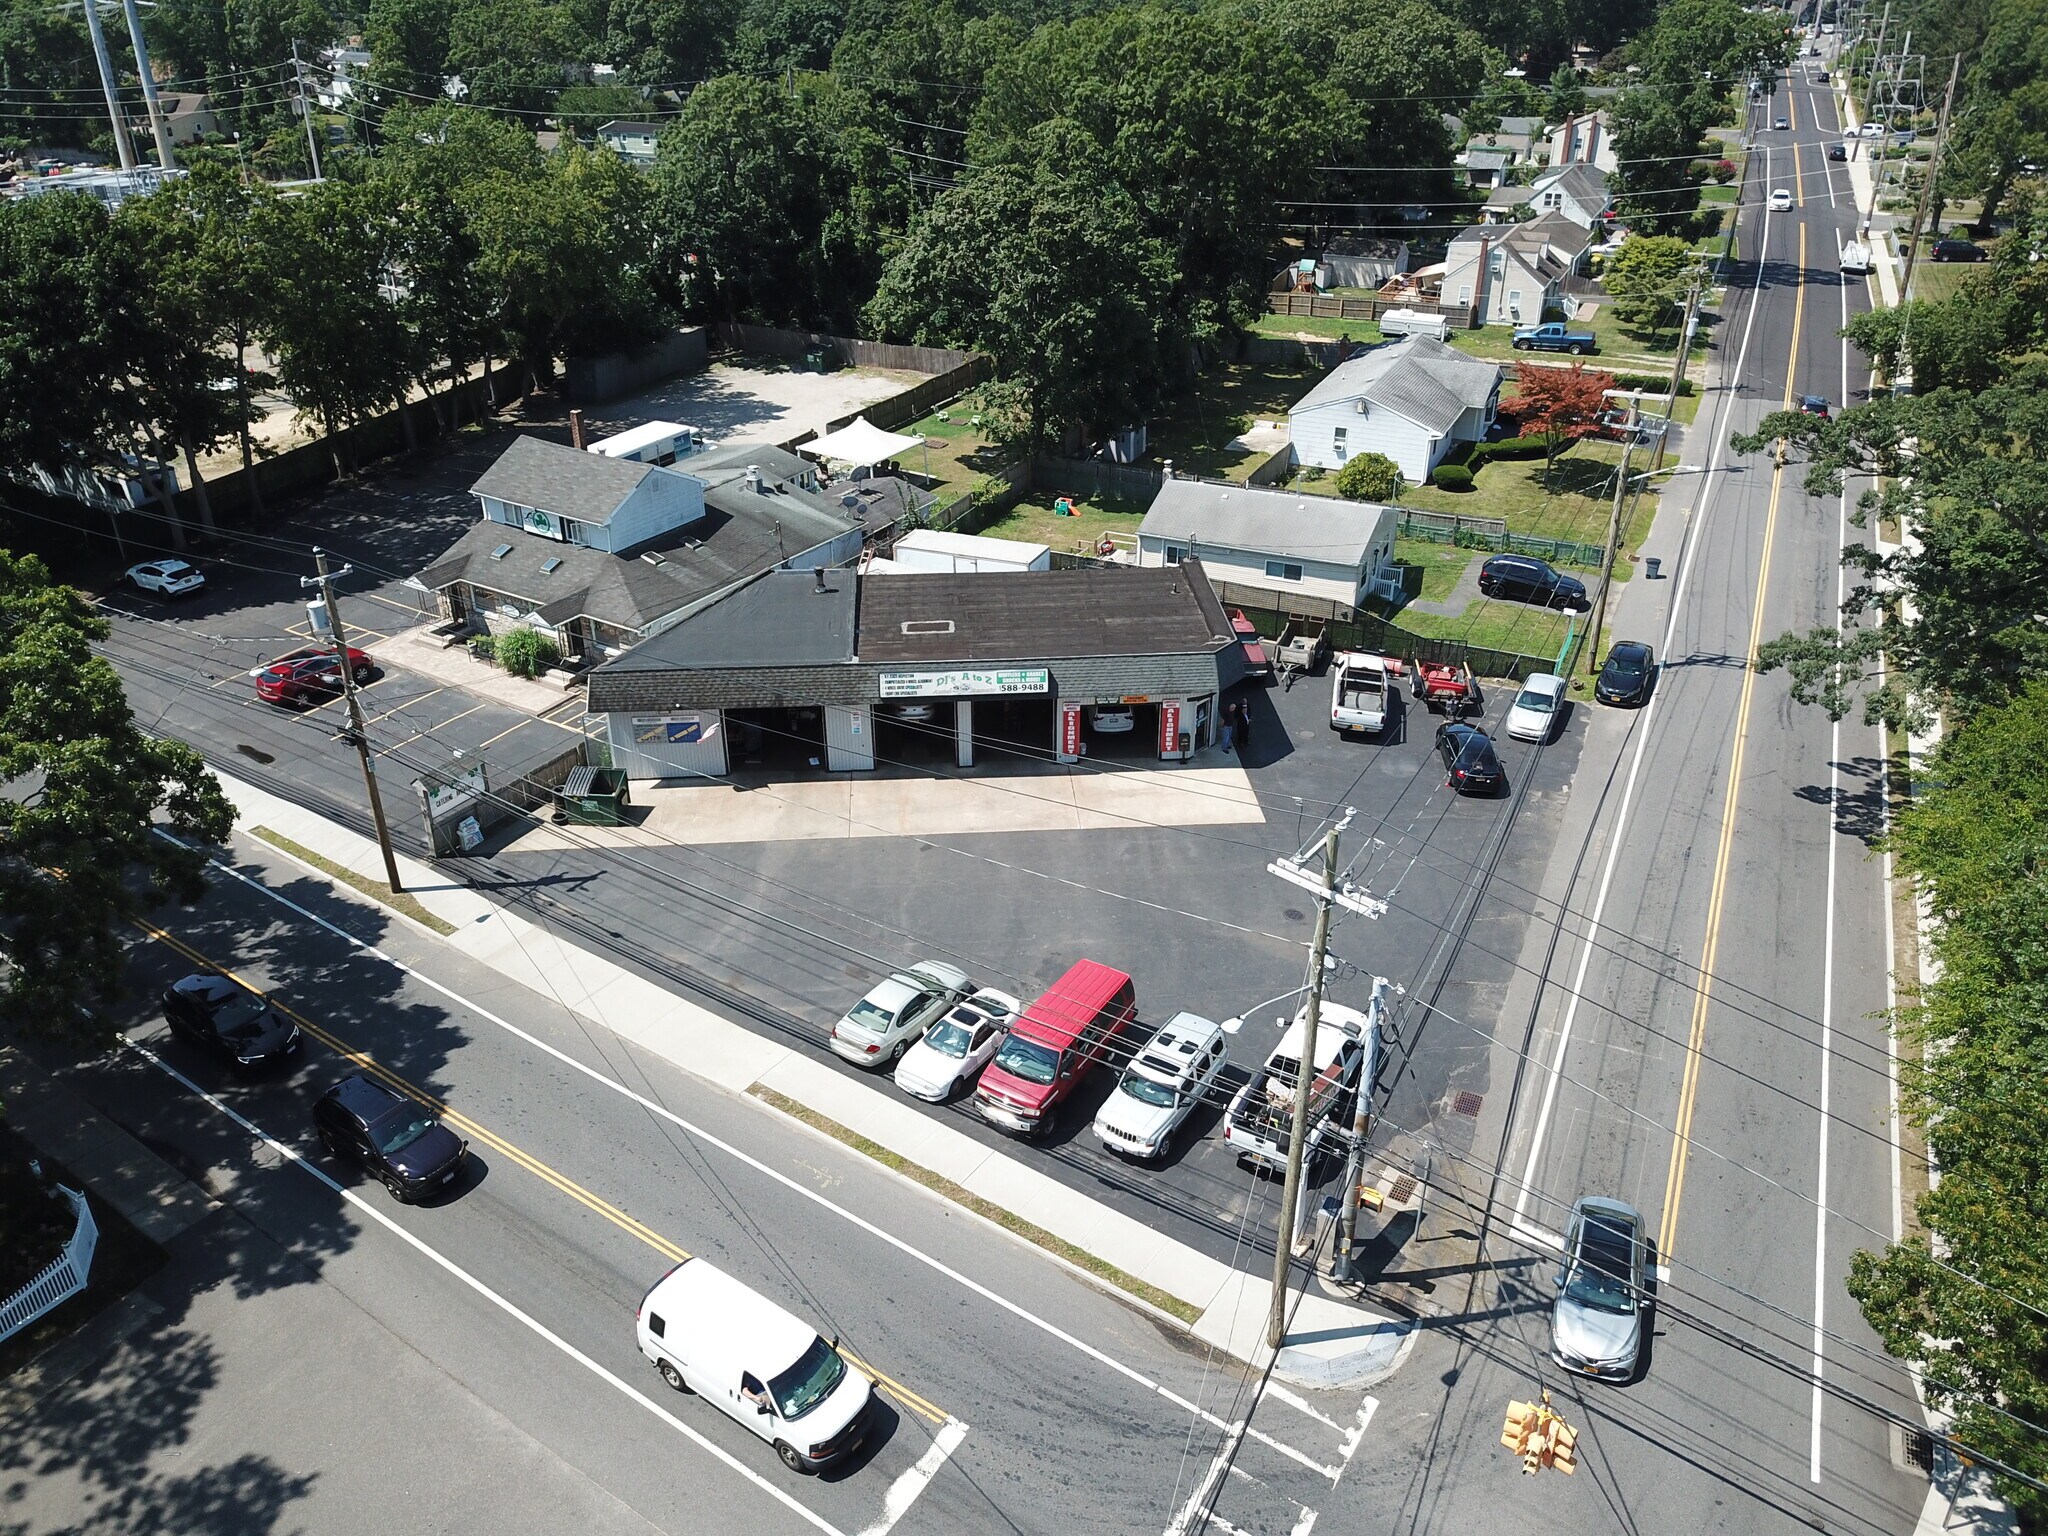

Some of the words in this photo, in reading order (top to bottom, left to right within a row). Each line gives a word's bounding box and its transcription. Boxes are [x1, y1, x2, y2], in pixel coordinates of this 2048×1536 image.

[962, 672, 970, 680] A
[973, 674, 982, 682] to
[985, 675, 992, 685] Z
[1001, 683, 1044, 692] 588-9488
[1067, 711, 1075, 754] ALIGNMENT
[1165, 708, 1175, 751] ALIGNMENT
